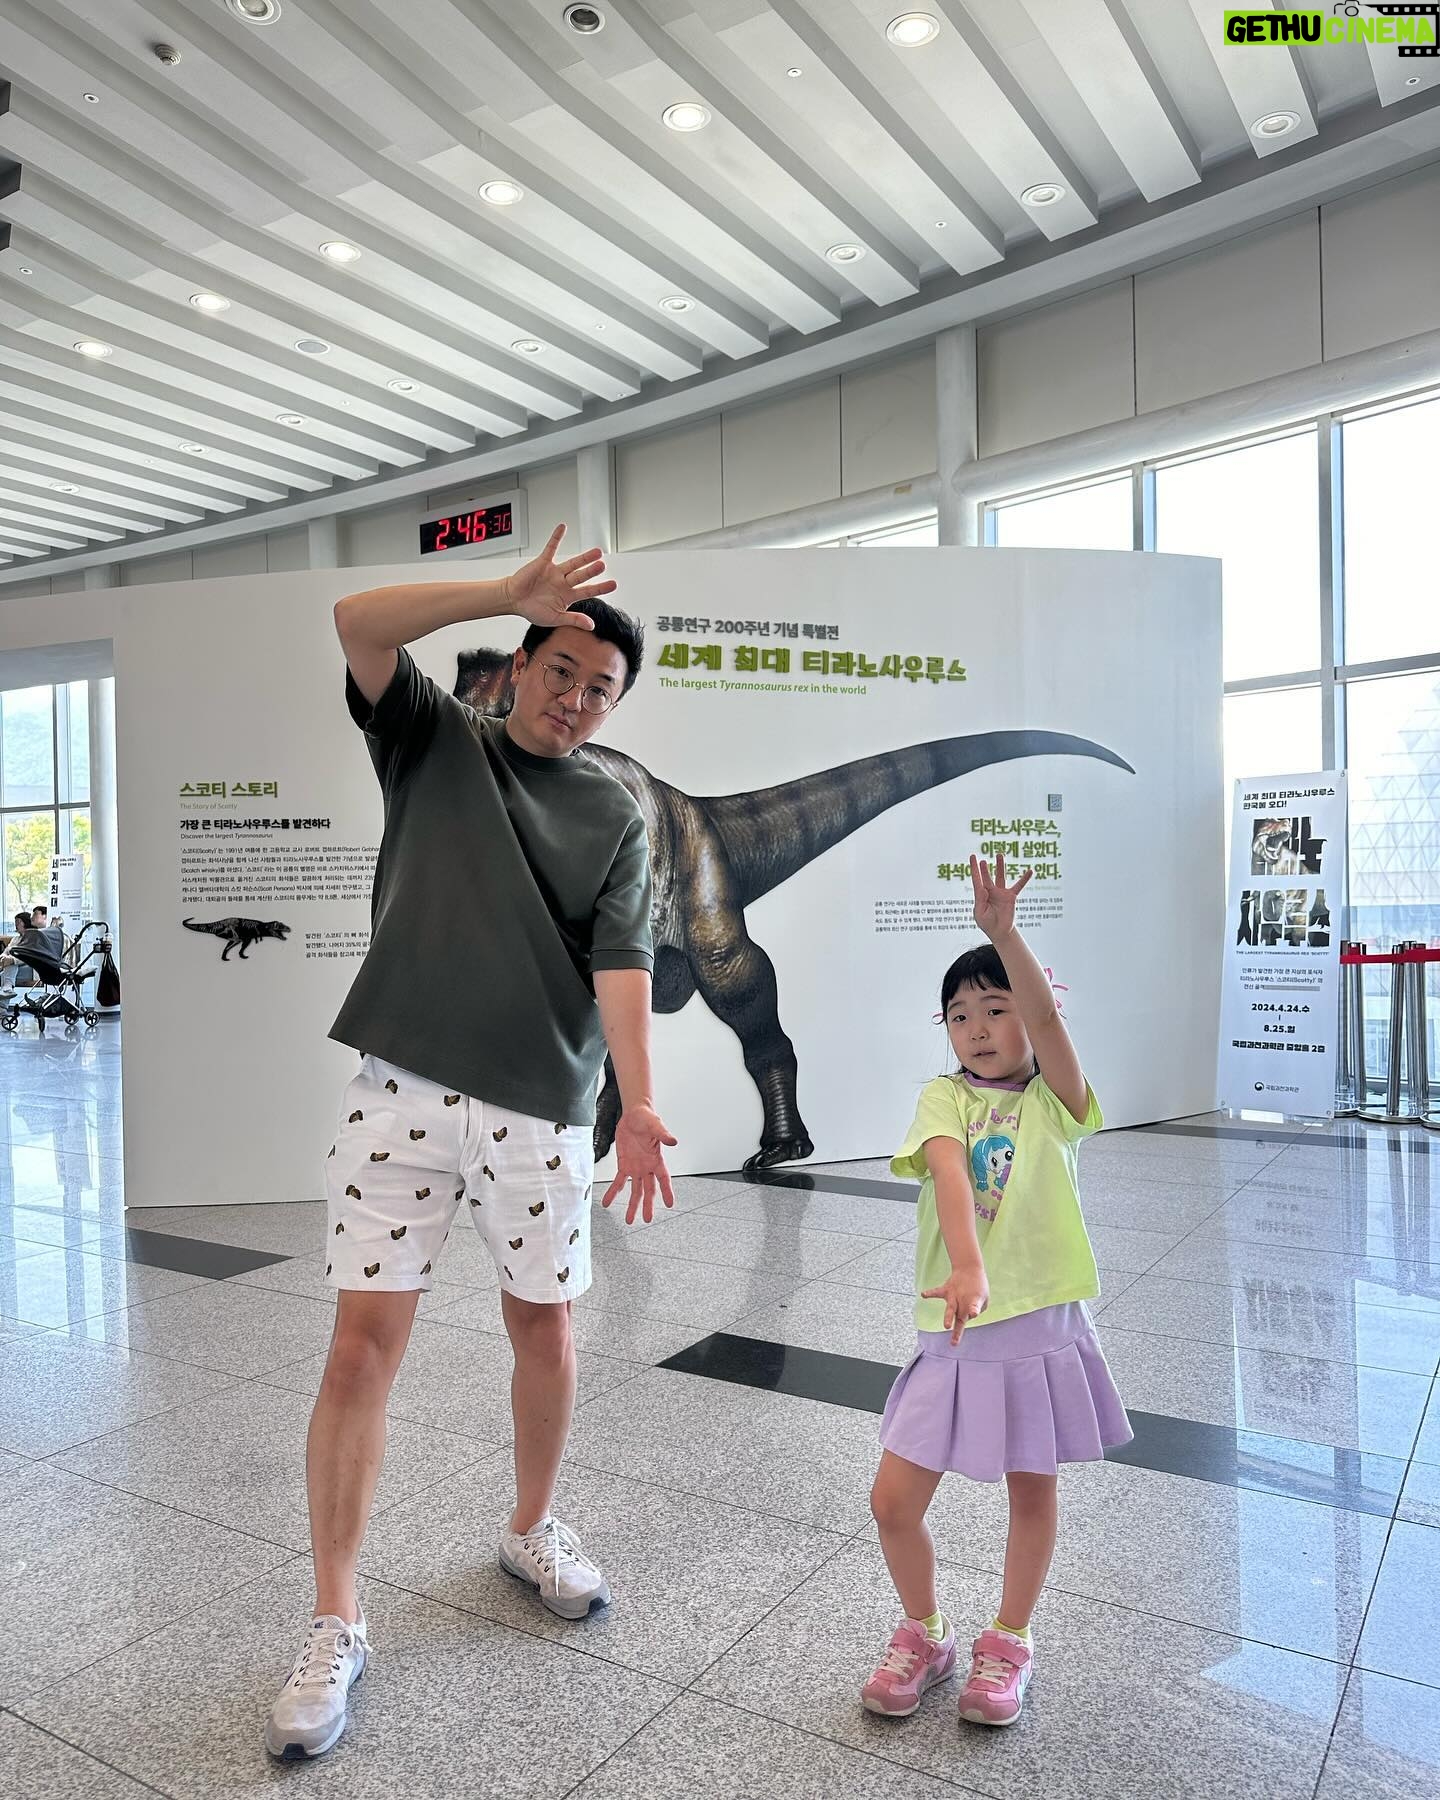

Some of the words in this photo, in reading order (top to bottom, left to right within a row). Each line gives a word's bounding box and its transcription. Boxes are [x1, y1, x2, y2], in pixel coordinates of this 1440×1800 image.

[657, 615, 711, 634] 공룡연구
[715, 619, 770, 637] 200주년
[773, 621, 799, 639] 기념
[802, 622, 840, 641] 특별전
[656, 642, 723, 671] 세계
[734, 645, 791, 673] 최대
[802, 649, 968, 684] 티라노사우루스
[659, 677, 680, 688] The
[681, 678, 718, 692] largest
[719, 679, 792, 693] Tyrannosaurus
[793, 684, 809, 693] rex
[810, 683, 820, 693] in
[821, 683, 838, 694] the
[839, 684, 867, 695] world
[180, 781, 226, 799] 스코티
[231, 781, 278, 799] 스토리
[1244, 793, 1259, 801] 세계
[1261, 791, 1277, 800] 최대
[1279, 788, 1335, 799] 티라노사우루스
[1243, 802, 1266, 810] 한국에
[1268, 800, 1287, 809] 오다!
[180, 818, 199, 831] 가장
[202, 819, 211, 831] 큰
[214, 818, 290, 831] 티라노사우루스를
[293, 818, 331, 830] 발견하다
[970, 818, 1061, 838] 티라노사우루스,
[181, 832, 204, 840] Discover
[215, 832, 234, 840] largest
[981, 841, 1018, 858] 이렇게
[1022, 841, 1062, 858] 살았다.
[1034, 863, 1062, 880] 있다.
[1251, 1003, 1310, 1013] 2024.4.24.수
[1264, 1024, 1295, 1034] 8.25.일
[1232, 1040, 1284, 1051] 국립과천과학관
